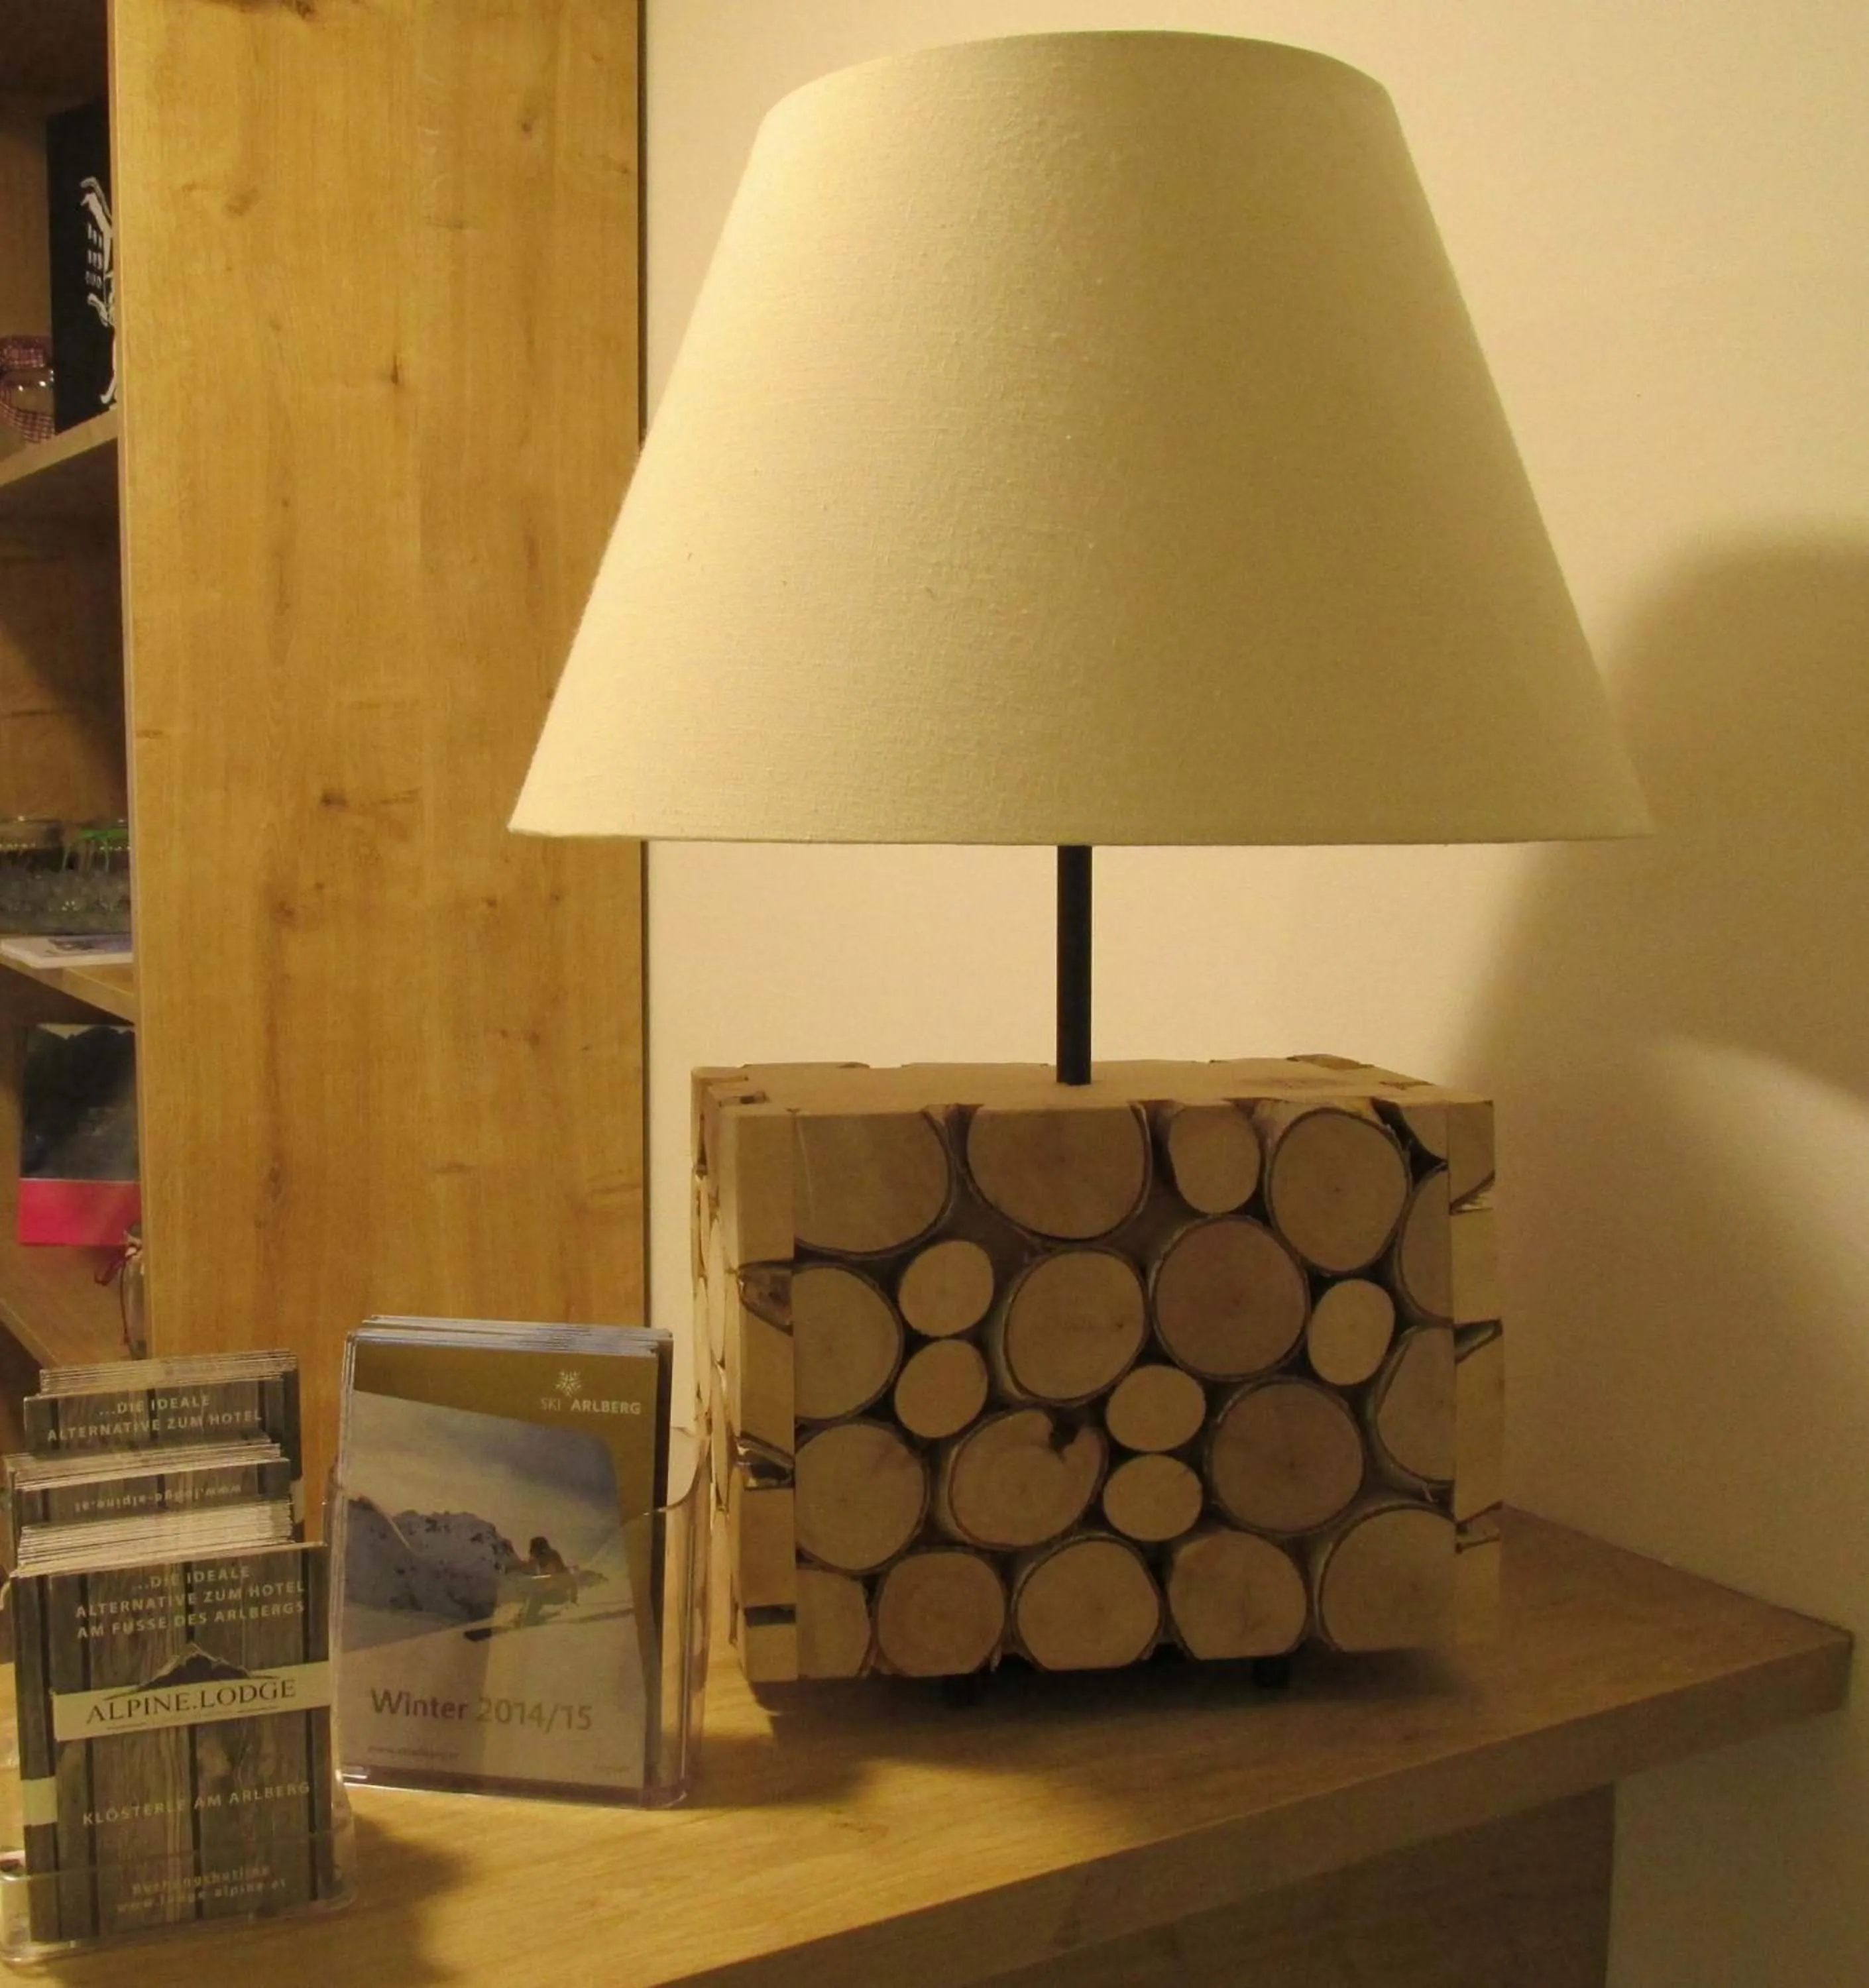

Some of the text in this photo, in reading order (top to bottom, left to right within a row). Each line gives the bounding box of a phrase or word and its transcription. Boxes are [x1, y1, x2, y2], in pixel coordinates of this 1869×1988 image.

[150, 1394, 210, 1411] IDEALE
[539, 1398, 642, 1415] SKI ARLBERG
[47, 1409, 262, 1443] ALTERNATIVE ZUM HOTEL
[186, 1565, 251, 1584] IDEALE
[75, 1580, 306, 1619] ALTERNATIVE ZUM HOTEL
[77, 1624, 105, 1640] AM
[174, 1611, 207, 1628] DES
[213, 1600, 305, 1624] ARLBERGS
[85, 1679, 297, 1724] ALPINE.LODGE
[370, 1687, 593, 1735] Winter 2014/15
[194, 1795, 222, 1810] AM
[229, 1781, 310, 1805] ARLBERG
